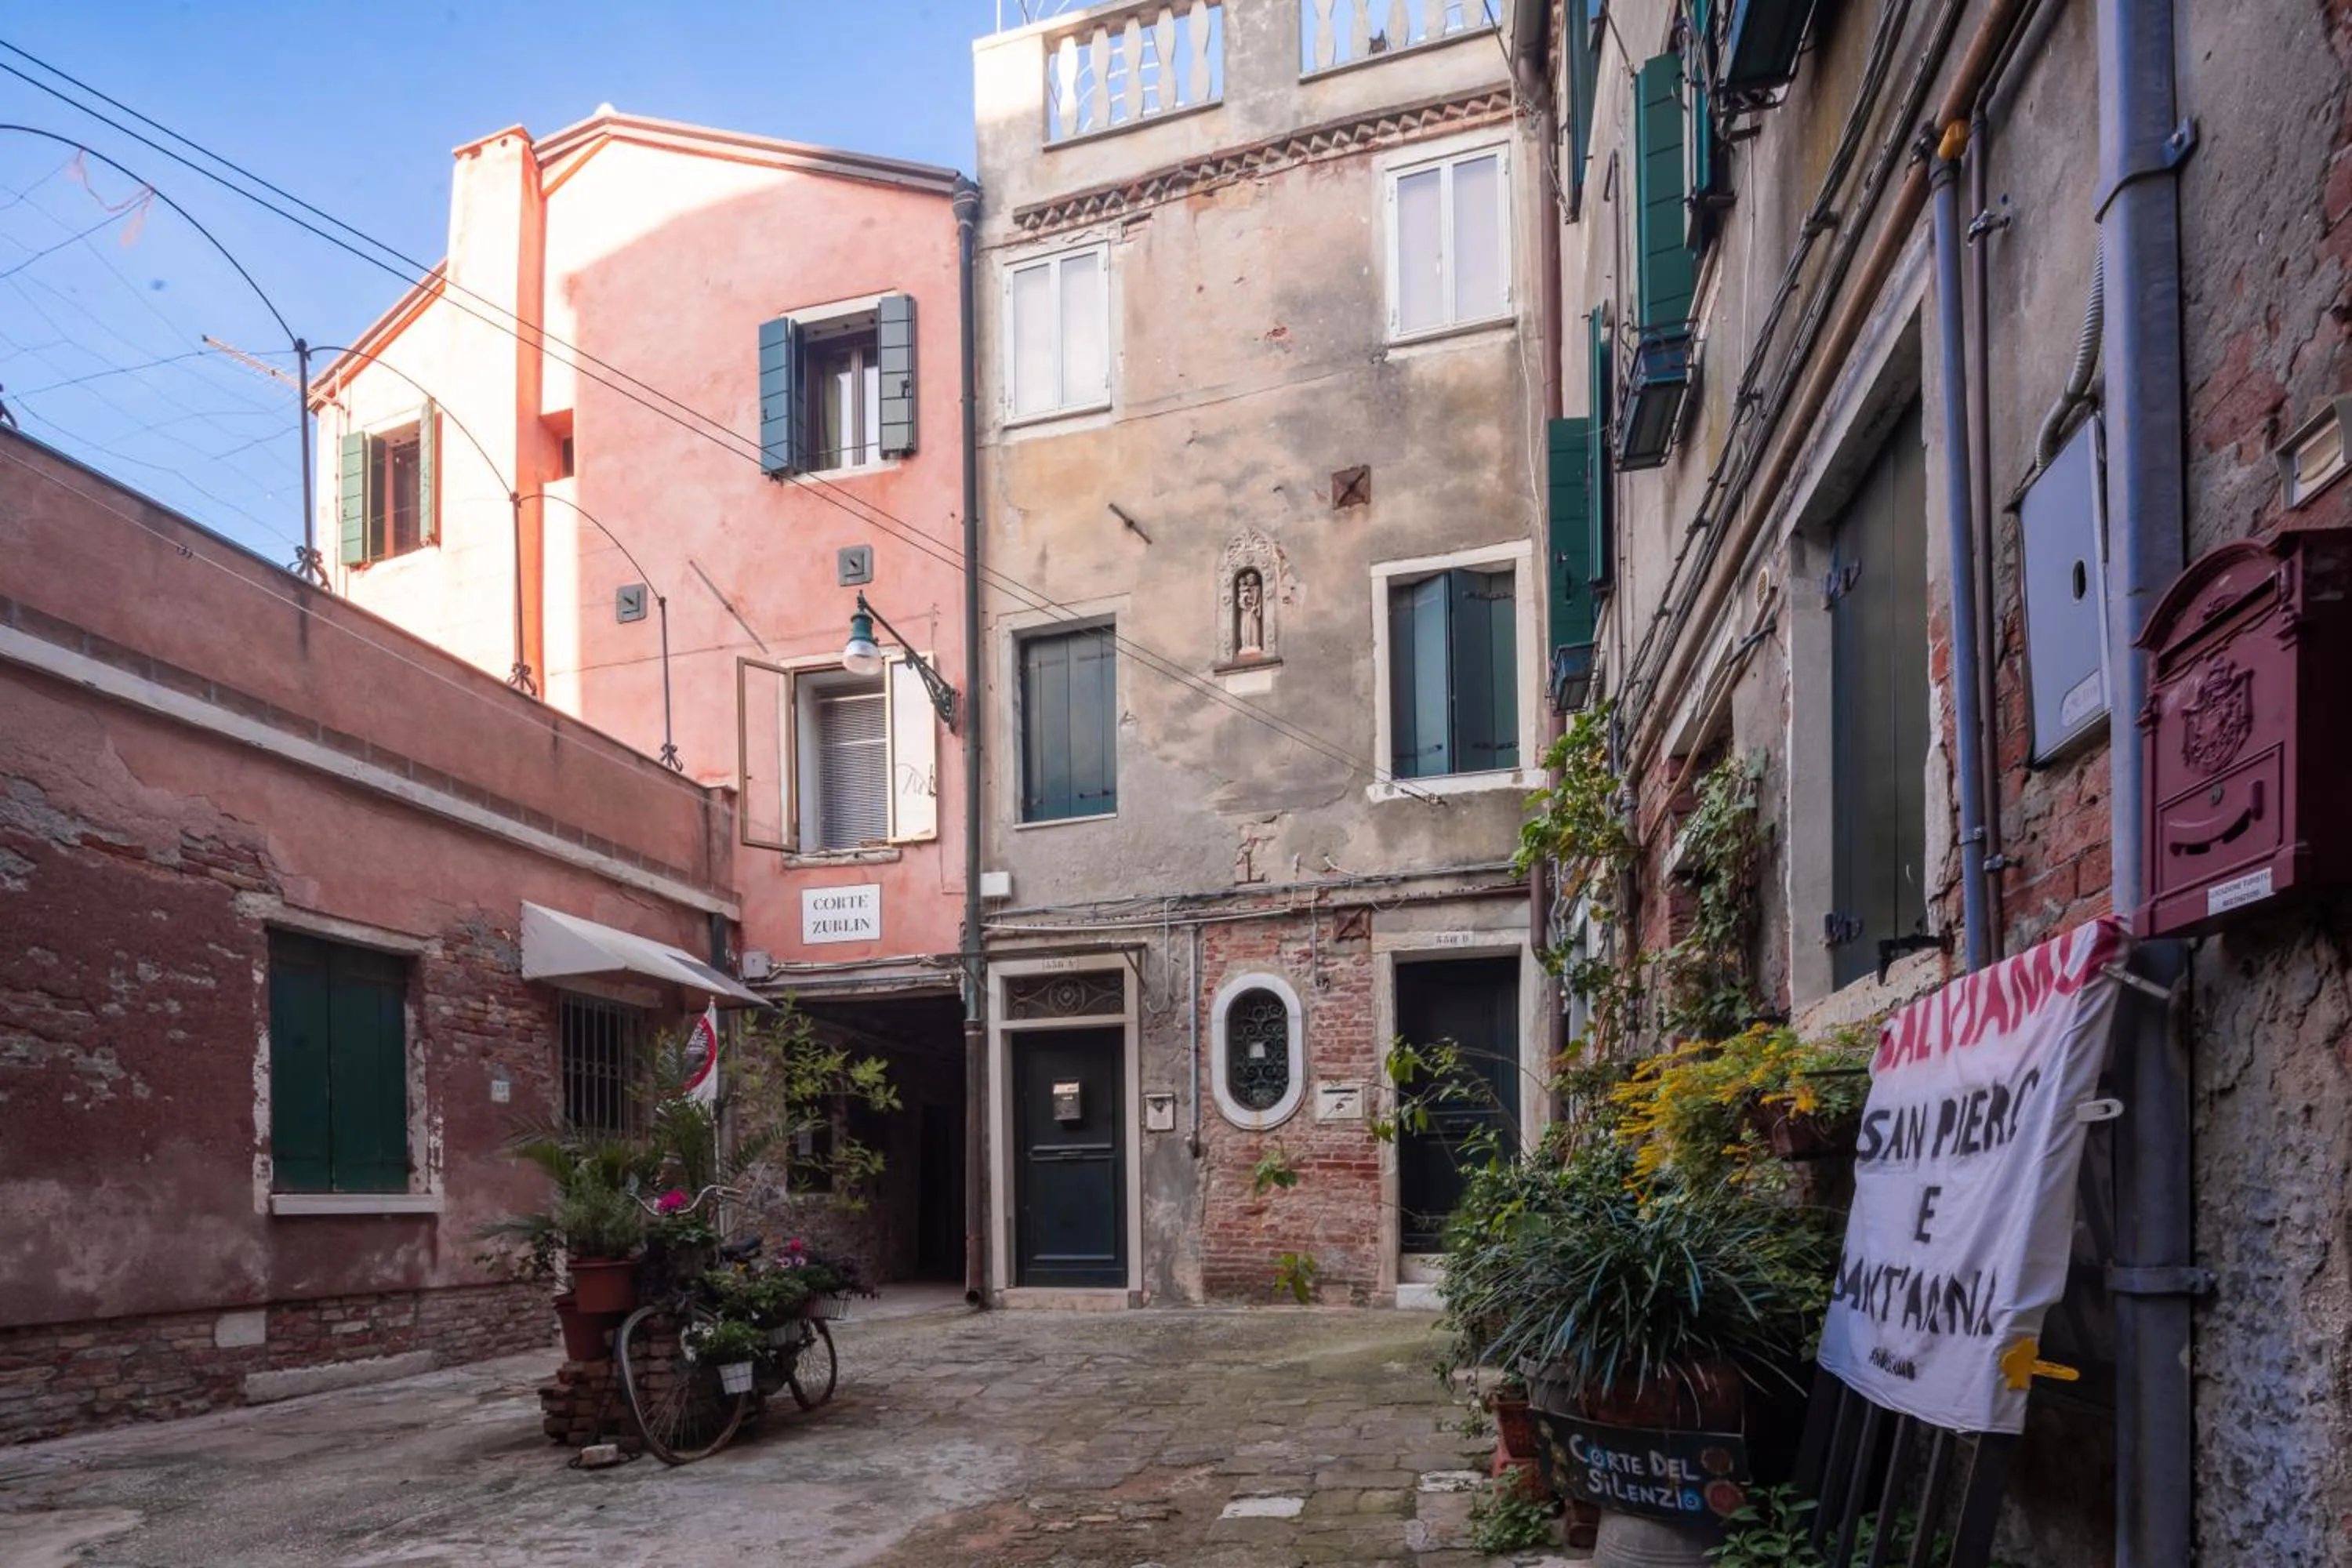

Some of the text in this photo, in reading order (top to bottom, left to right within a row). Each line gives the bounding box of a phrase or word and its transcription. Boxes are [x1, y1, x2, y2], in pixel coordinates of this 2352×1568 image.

[812, 918, 870, 935] ZURLIN
[813, 895, 869, 910] CORTE
[1860, 1102, 1928, 1162] SAN
[1913, 1185, 1943, 1244] E
[1569, 1433, 1700, 1481] CORTE DEL
